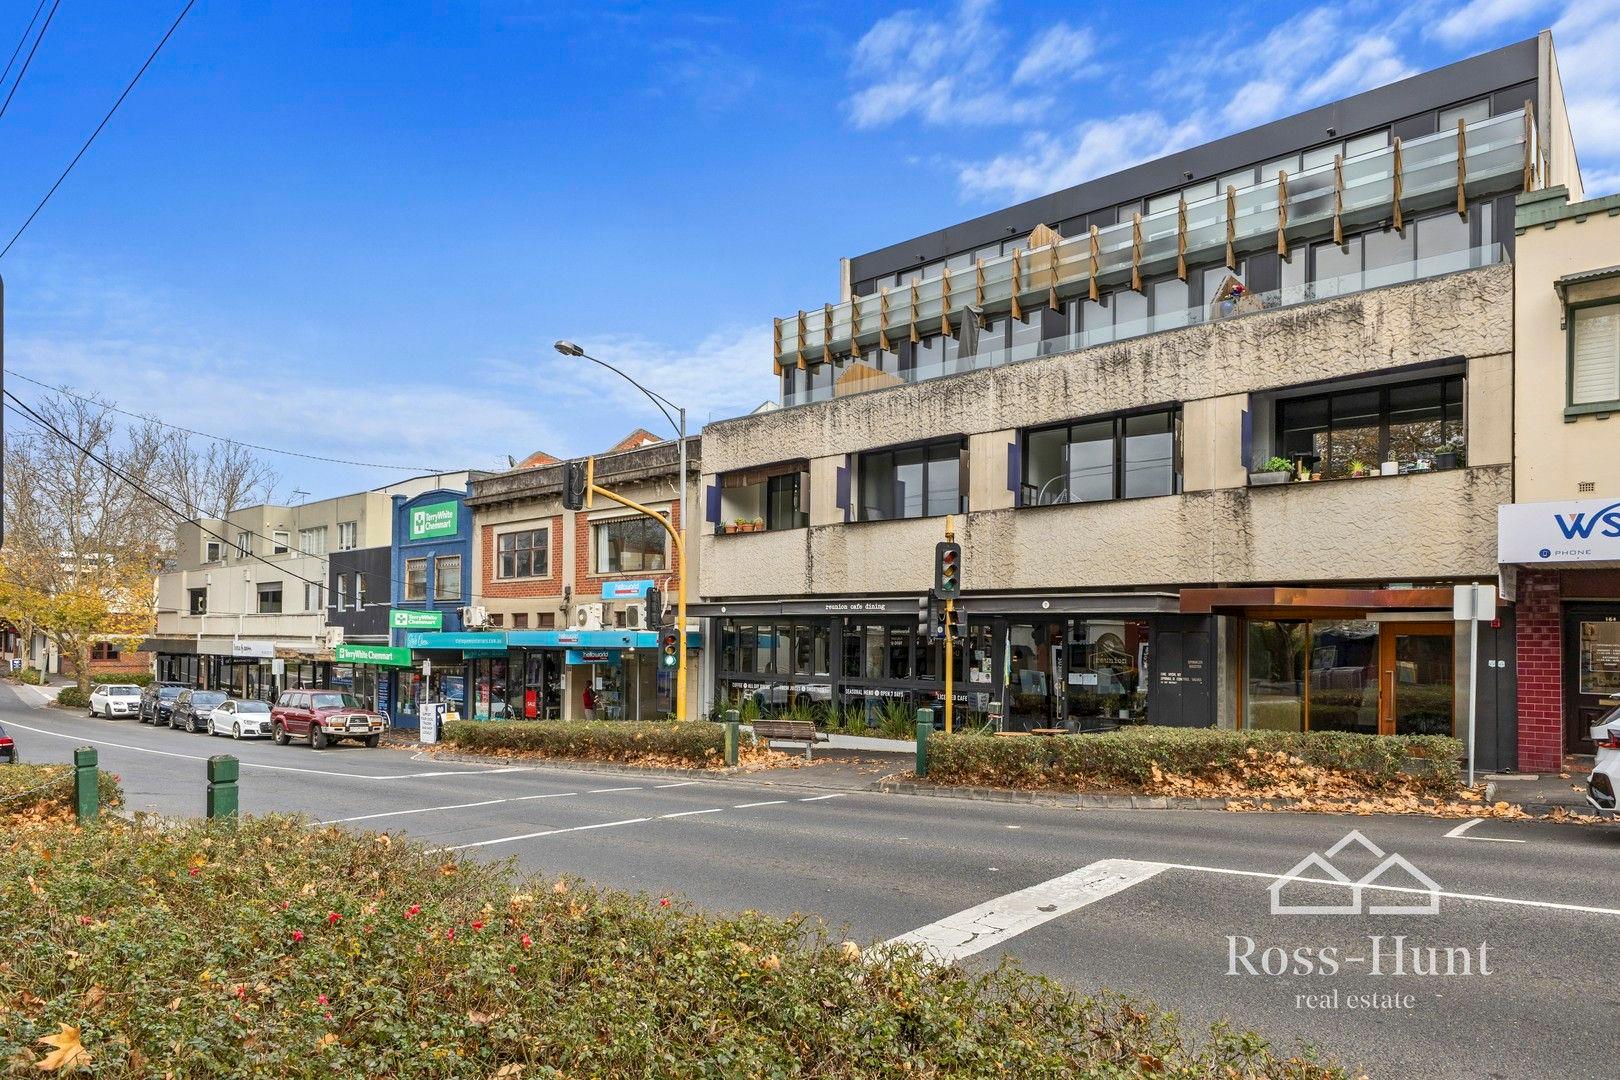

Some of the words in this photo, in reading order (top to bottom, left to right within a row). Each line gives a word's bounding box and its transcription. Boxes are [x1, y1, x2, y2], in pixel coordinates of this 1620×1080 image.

[425, 510, 453, 522] TerryWhite
[425, 520, 451, 531] Chemmart
[865, 603, 886, 611] dining
[957, 694, 968, 702] CAFE
